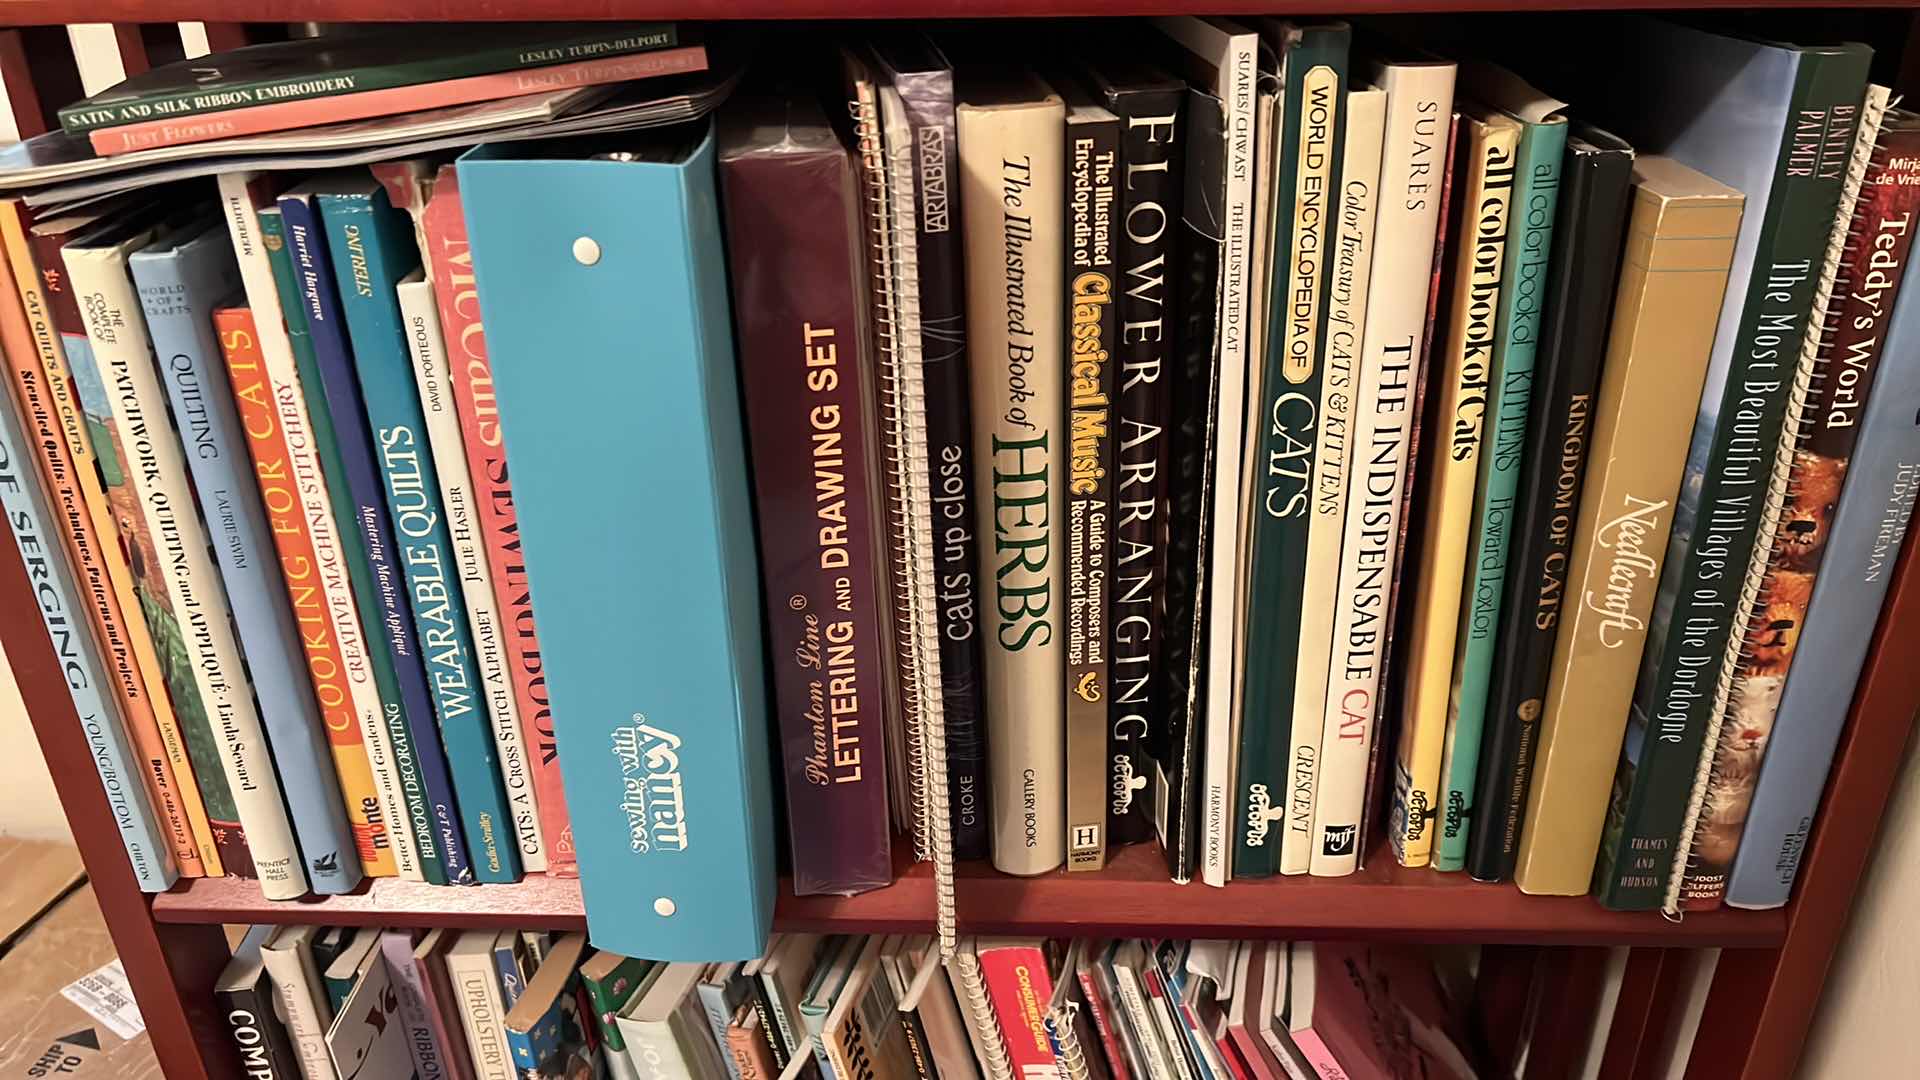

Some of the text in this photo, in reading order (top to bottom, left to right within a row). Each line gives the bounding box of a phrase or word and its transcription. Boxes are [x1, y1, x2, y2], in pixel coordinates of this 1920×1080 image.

[69, 75, 355, 128] SATIN AND SILK RIBBON EMBROIDERY
[519, 50, 563, 63] LESLEY
[1532, 164, 1557, 191] all
[1786, 111, 1825, 176] PALMER
[230, 197, 253, 256] MEREDITH
[1074, 138, 1094, 267] Encyclopedia of
[1094, 151, 1114, 266] The Illustrated
[1290, 85, 1329, 368] WORLD ENCYCLOPEDIA OF
[1524, 194, 1553, 259] color
[293, 225, 324, 321] Harriet Hargrave
[343, 225, 373, 297] STERLING
[1003, 155, 1036, 431] The Illustrated Book of
[1226, 202, 1244, 353] THE ILLUSTRATED CAT
[1452, 146, 1514, 461] all color book of Cats
[1513, 260, 1547, 323] book
[413, 316, 442, 412] DAVID PORTEOUS
[1319, 180, 1368, 516] Color Treasury of CATS & KITTENS
[1826, 212, 1911, 428] Teddy's World
[26, 290, 85, 455] CAT QUILTS AND CRAFTS
[1070, 272, 1112, 497] Classical Music
[1495, 368, 1532, 472] KITTENS
[111, 360, 157, 488] PATCHWORK,
[170, 354, 248, 569] QUILTING LAURIE SWIM
[1113, 112, 1177, 742] FLOWER ARRANGING
[1266, 392, 1316, 518] CATS
[935, 444, 965, 519] close
[1536, 393, 1590, 632] KINGDOM OF CATS
[1656, 259, 1811, 744] The Most Beautiful Villages of the Dordogne
[1864, 463, 1907, 583] JUDY FIREMAN
[20, 369, 48, 439] Stenciled
[60, 487, 92, 568] Techniques,
[86, 566, 111, 623] Patterns
[106, 623, 119, 645] and
[113, 645, 138, 699] Projects
[148, 490, 190, 577] QUILTING
[225, 329, 350, 733] COOKING FOR CATS
[272, 381, 367, 684] CREATIVE MACHINE STITCHERY
[362, 504, 384, 564] Mastering
[377, 564, 397, 609] Machine
[379, 425, 473, 720] WEARABLE QUILTS
[449, 485, 484, 583] JULIE HASLER
[804, 323, 862, 783] LETTERING AND DRAWING SET
[944, 527, 972, 562] up
[991, 429, 1052, 652] HERBS
[1339, 335, 1414, 744] THE INDISPENSABLE CAT
[1472, 497, 1513, 640] Howard Loxton
[1586, 493, 1670, 649] Needlecraft
[181, 579, 200, 607] and
[11, 508, 135, 829] SERGING YOUNG/BOTTOM
[217, 703, 240, 742] Linda
[225, 741, 257, 792] Seward
[475, 608, 540, 856] CATS: A CROSS STITCH ALPHABET
[611, 726, 643, 777] with
[803, 679, 829, 786] Phantom
[385, 703, 436, 859] BEDROOM DECORATING
[620, 777, 650, 855] sewing
[960, 775, 976, 826] CROKE
[1022, 768, 1037, 849] GALLERY BOOKS
[1207, 785, 1220, 868] HARMONY BOOKS
[1292, 744, 1316, 837] CRESCENT
[256, 857, 292, 870] PRENTICE
[265, 866, 286, 876] HALL
[266, 873, 290, 882] PRESS
[1619, 876, 1660, 888] HUDSON
[1631, 837, 1668, 850] THAMES
[1634, 857, 1656, 869] AND
[465, 979, 503, 1068] UPHOLSTERY
[1016, 965, 1041, 1022] CONSUMER
[1030, 1022, 1049, 1053] GUIDE
[28, 1044, 65, 1078] SHIP
[54, 1055, 83, 1075] TO
